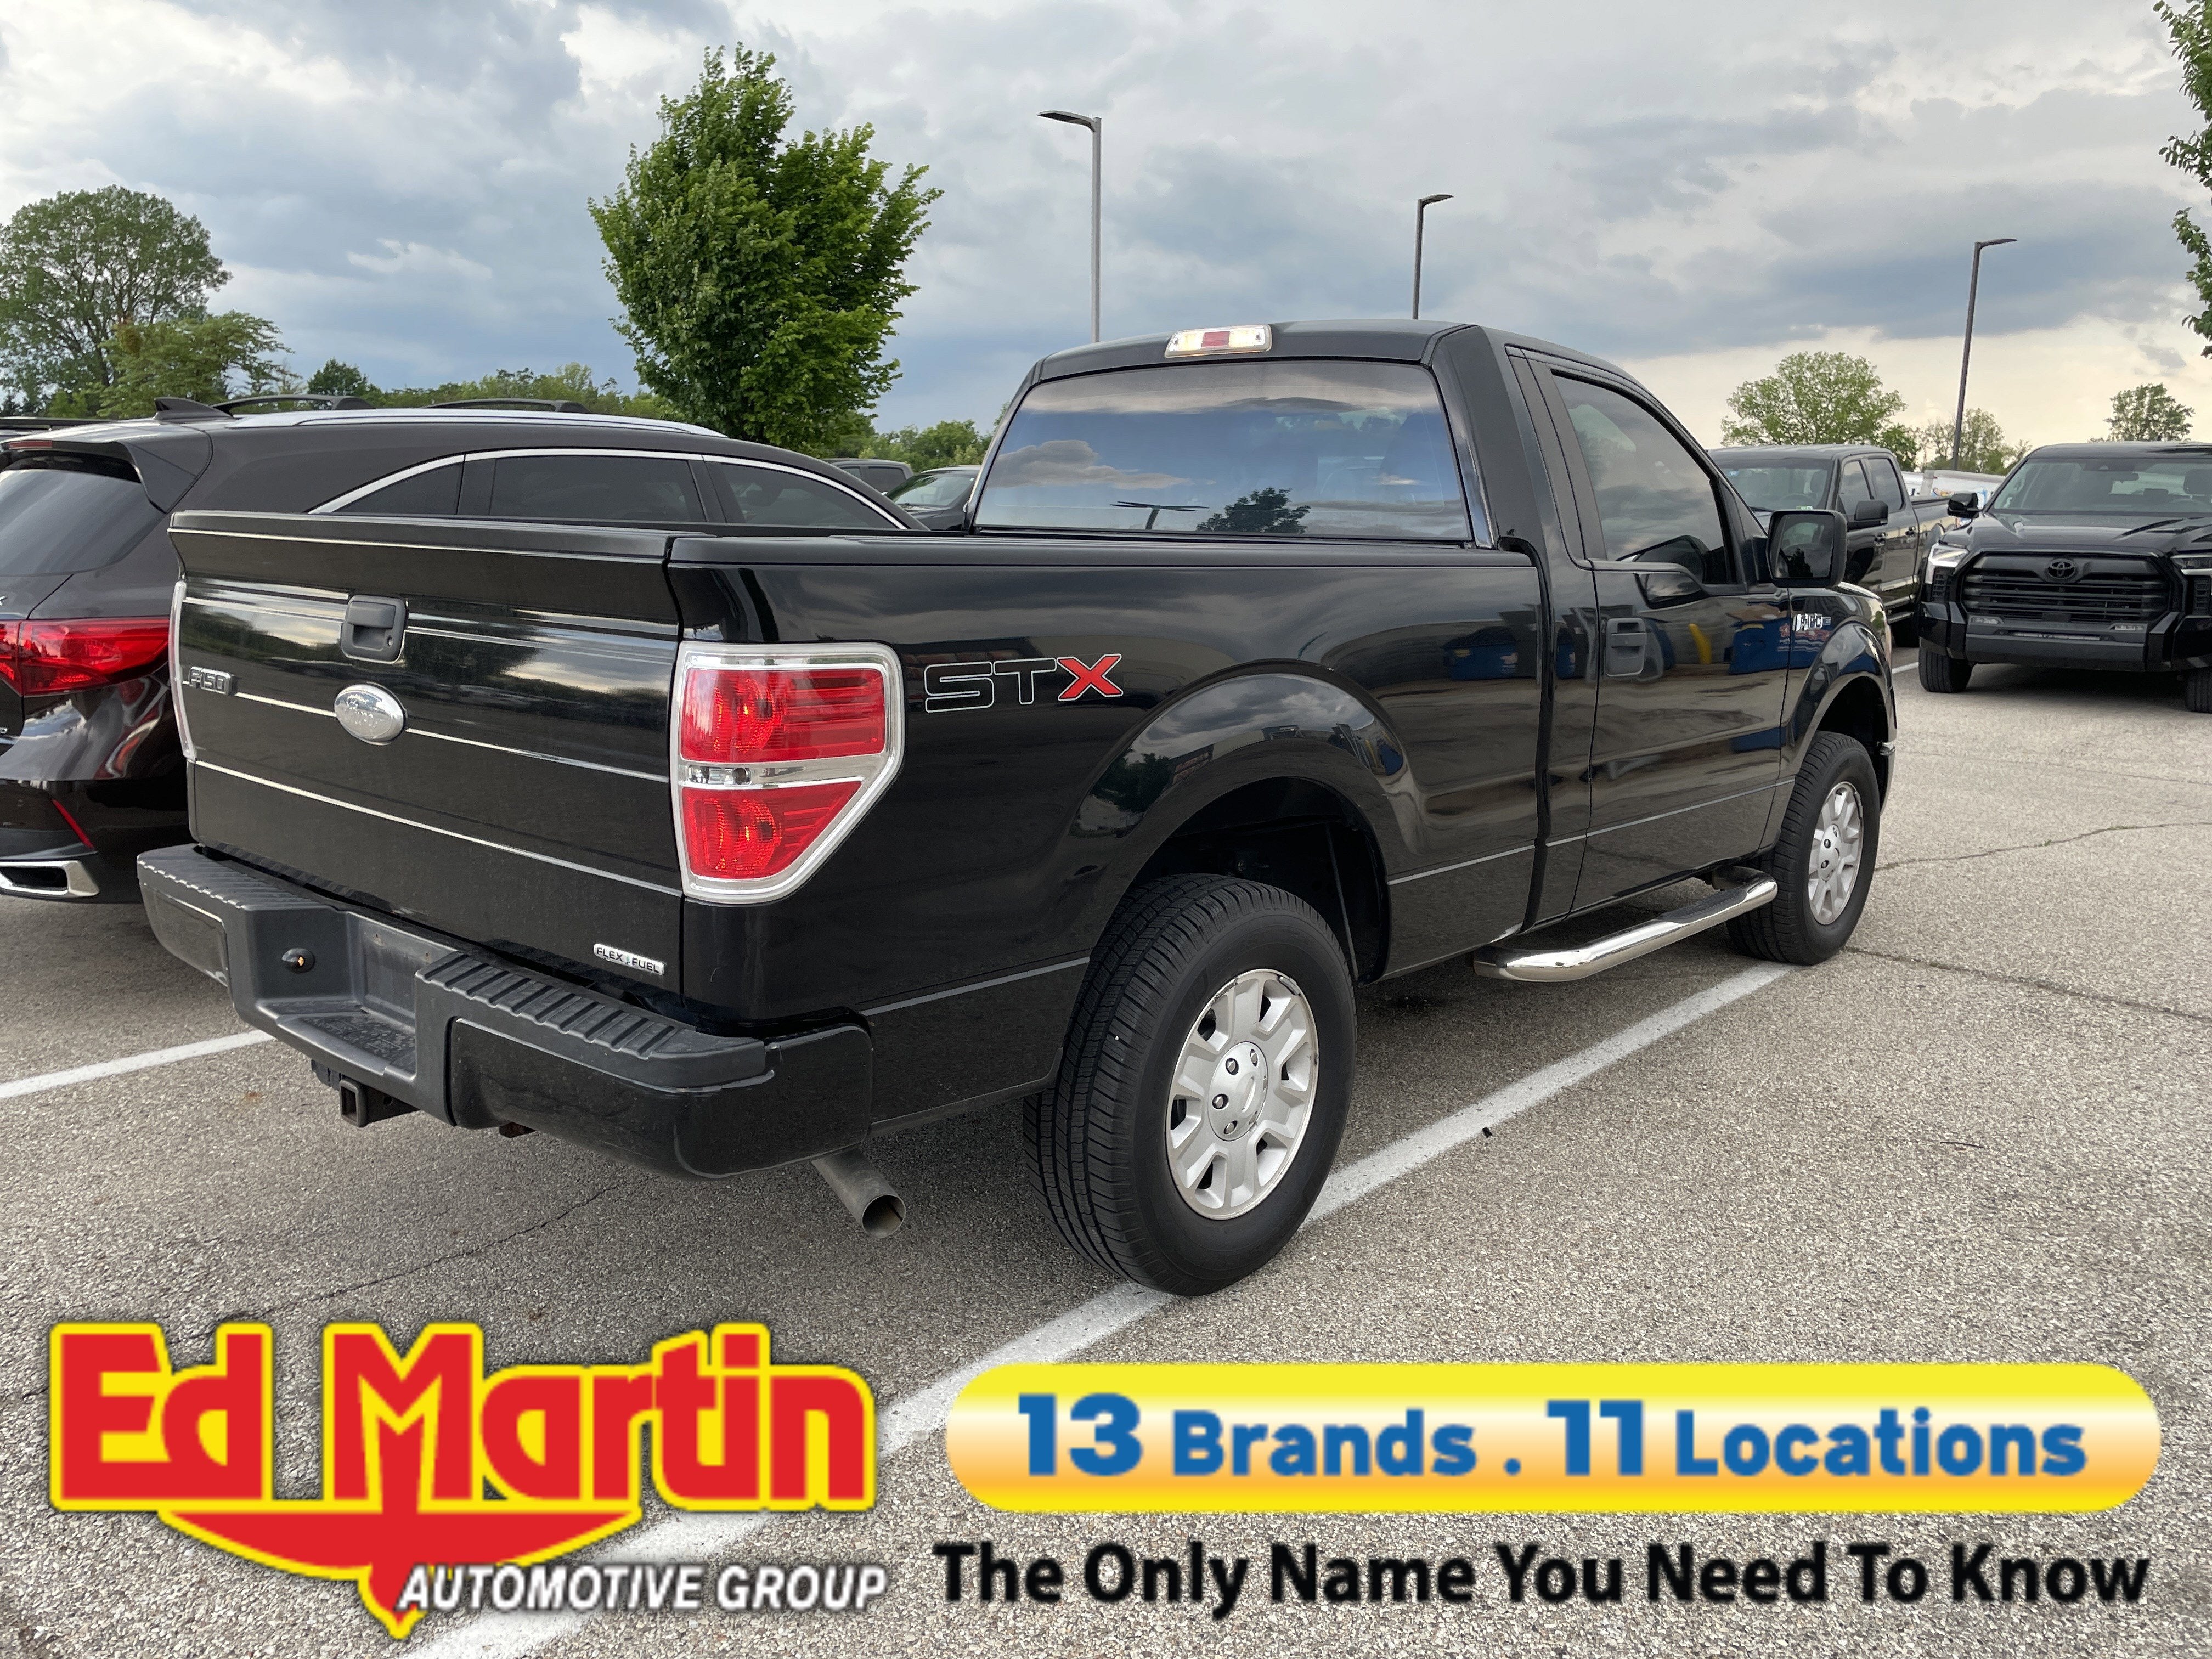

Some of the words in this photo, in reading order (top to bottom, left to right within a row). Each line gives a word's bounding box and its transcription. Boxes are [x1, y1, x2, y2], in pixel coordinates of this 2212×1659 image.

[924, 653, 1123, 713] STX
[596, 947, 623, 962] FLEX
[631, 957, 660, 973] FUEL
